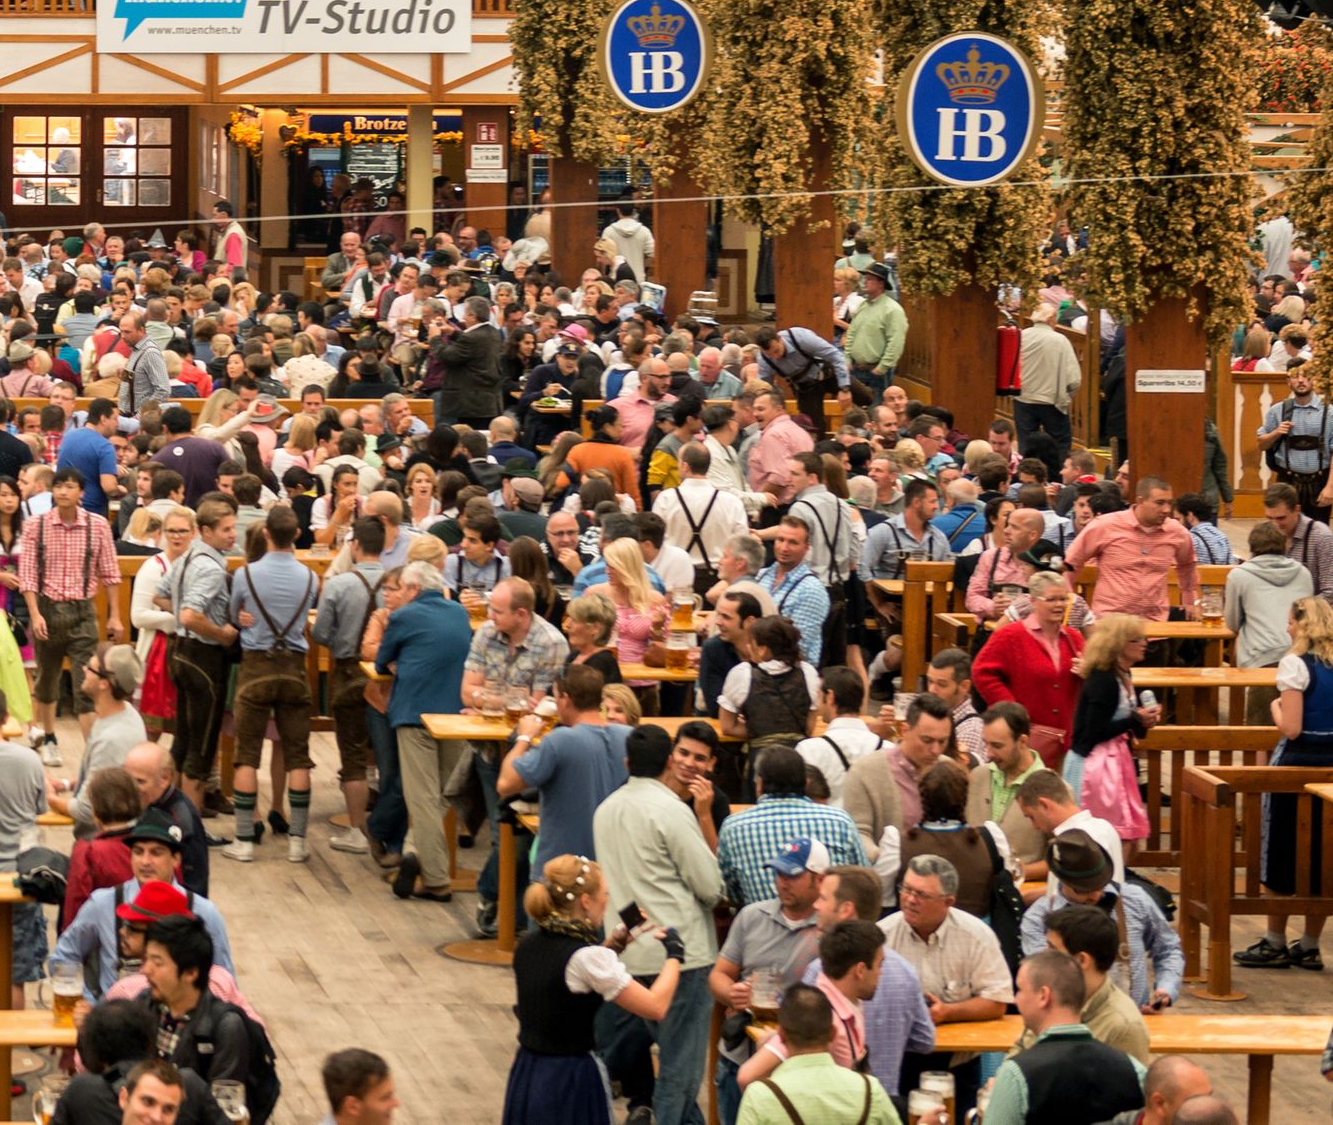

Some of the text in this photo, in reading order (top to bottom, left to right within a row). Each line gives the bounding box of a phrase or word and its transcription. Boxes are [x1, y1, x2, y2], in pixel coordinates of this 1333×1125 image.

[147, 25, 243, 35] www.muenchen.tv
[628, 50, 686, 95] HB
[933, 107, 1008, 163] HB
